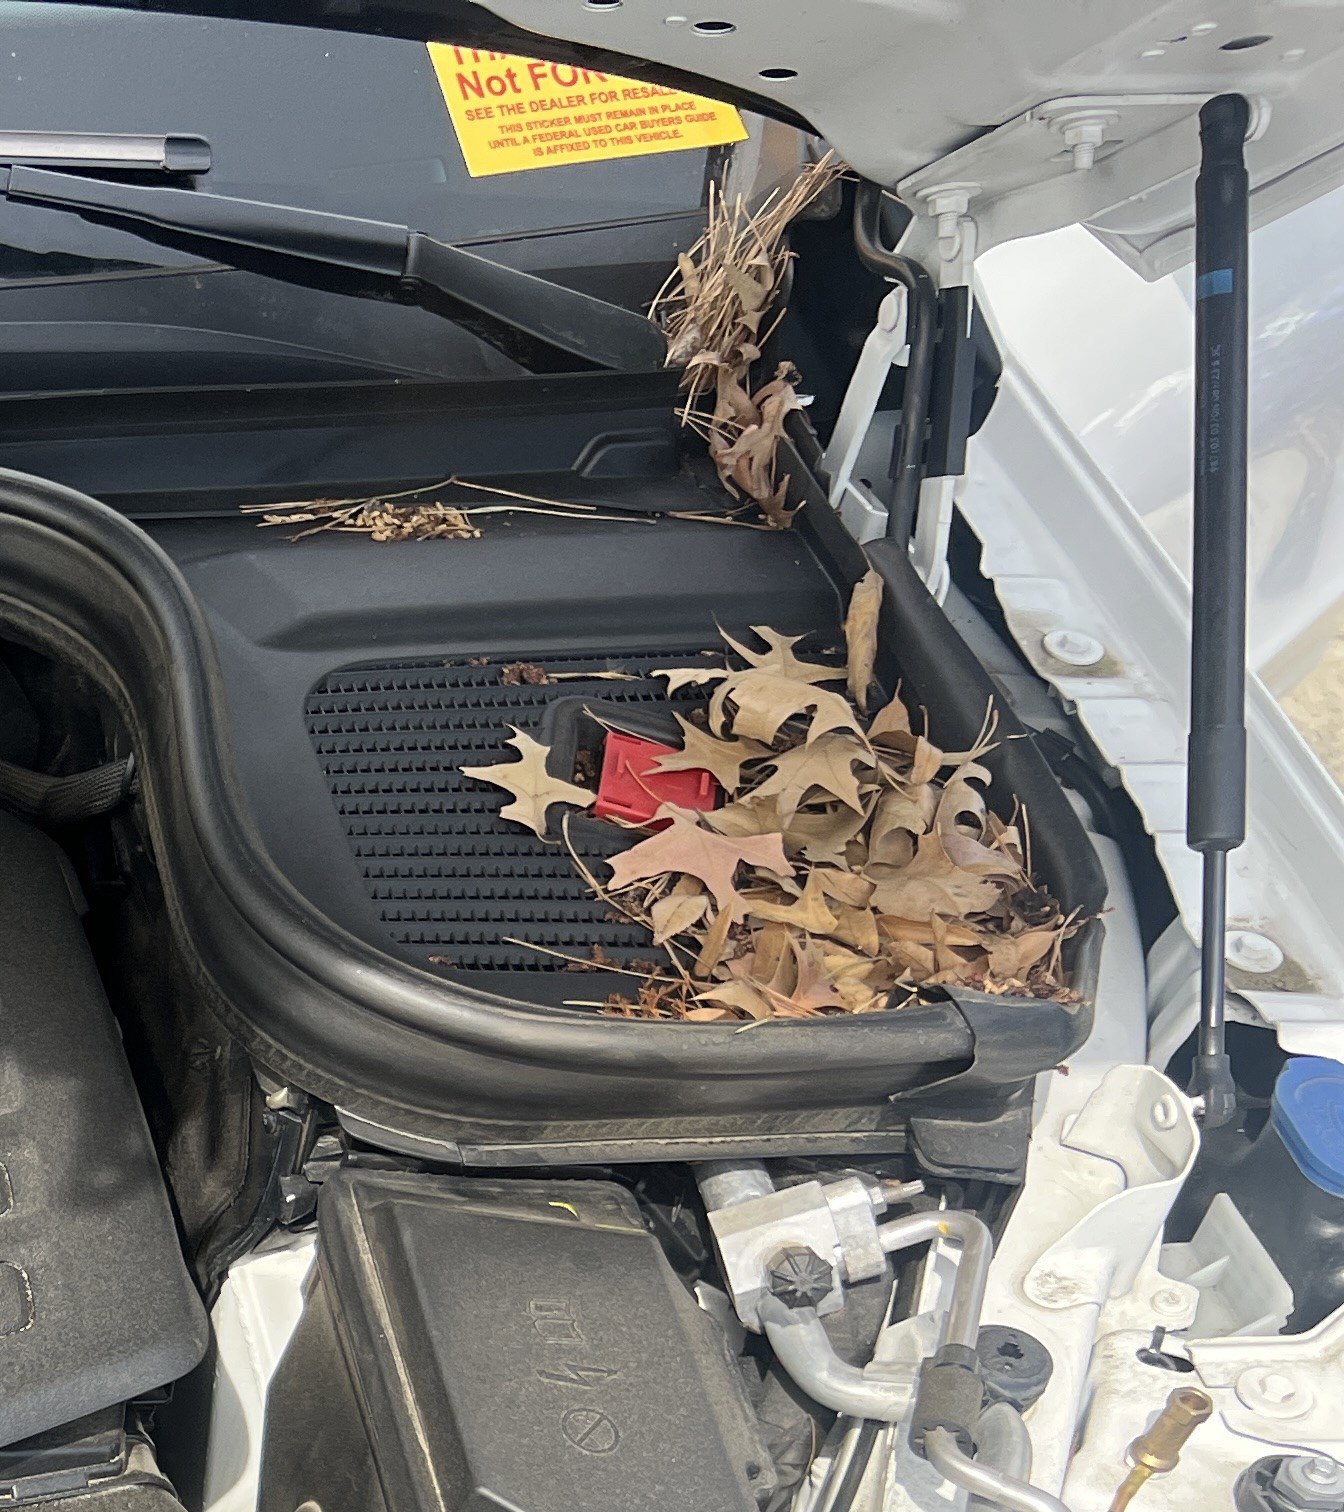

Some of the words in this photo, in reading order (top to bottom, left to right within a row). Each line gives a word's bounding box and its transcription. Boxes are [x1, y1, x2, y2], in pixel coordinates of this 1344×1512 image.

[456, 67, 521, 101] Not
[464, 107, 494, 122] SEE
[496, 102, 527, 117] THE
[529, 95, 588, 113] DEALER
[589, 90, 621, 105] FOR
[498, 122, 524, 135] THIS
[525, 116, 572, 131] STICKER
[573, 112, 602, 124] MUST
[605, 107, 647, 120] REMAIN
[647, 105, 660, 115] IN
[660, 101, 696, 113] PLACE
[488, 137, 521, 150] UNTIL
[523, 135, 531, 145] A
[531, 130, 582, 143] FEDERAL
[583, 124, 612, 137] USED
[615, 121, 639, 133] CAR
[639, 115, 683, 130] BUYERS
[684, 111, 717, 123] GUIDE
[532, 146, 544, 156] IS
[546, 140, 591, 155] AFFIXED
[592, 138, 608, 149] TO
[609, 135, 634, 147] THIS
